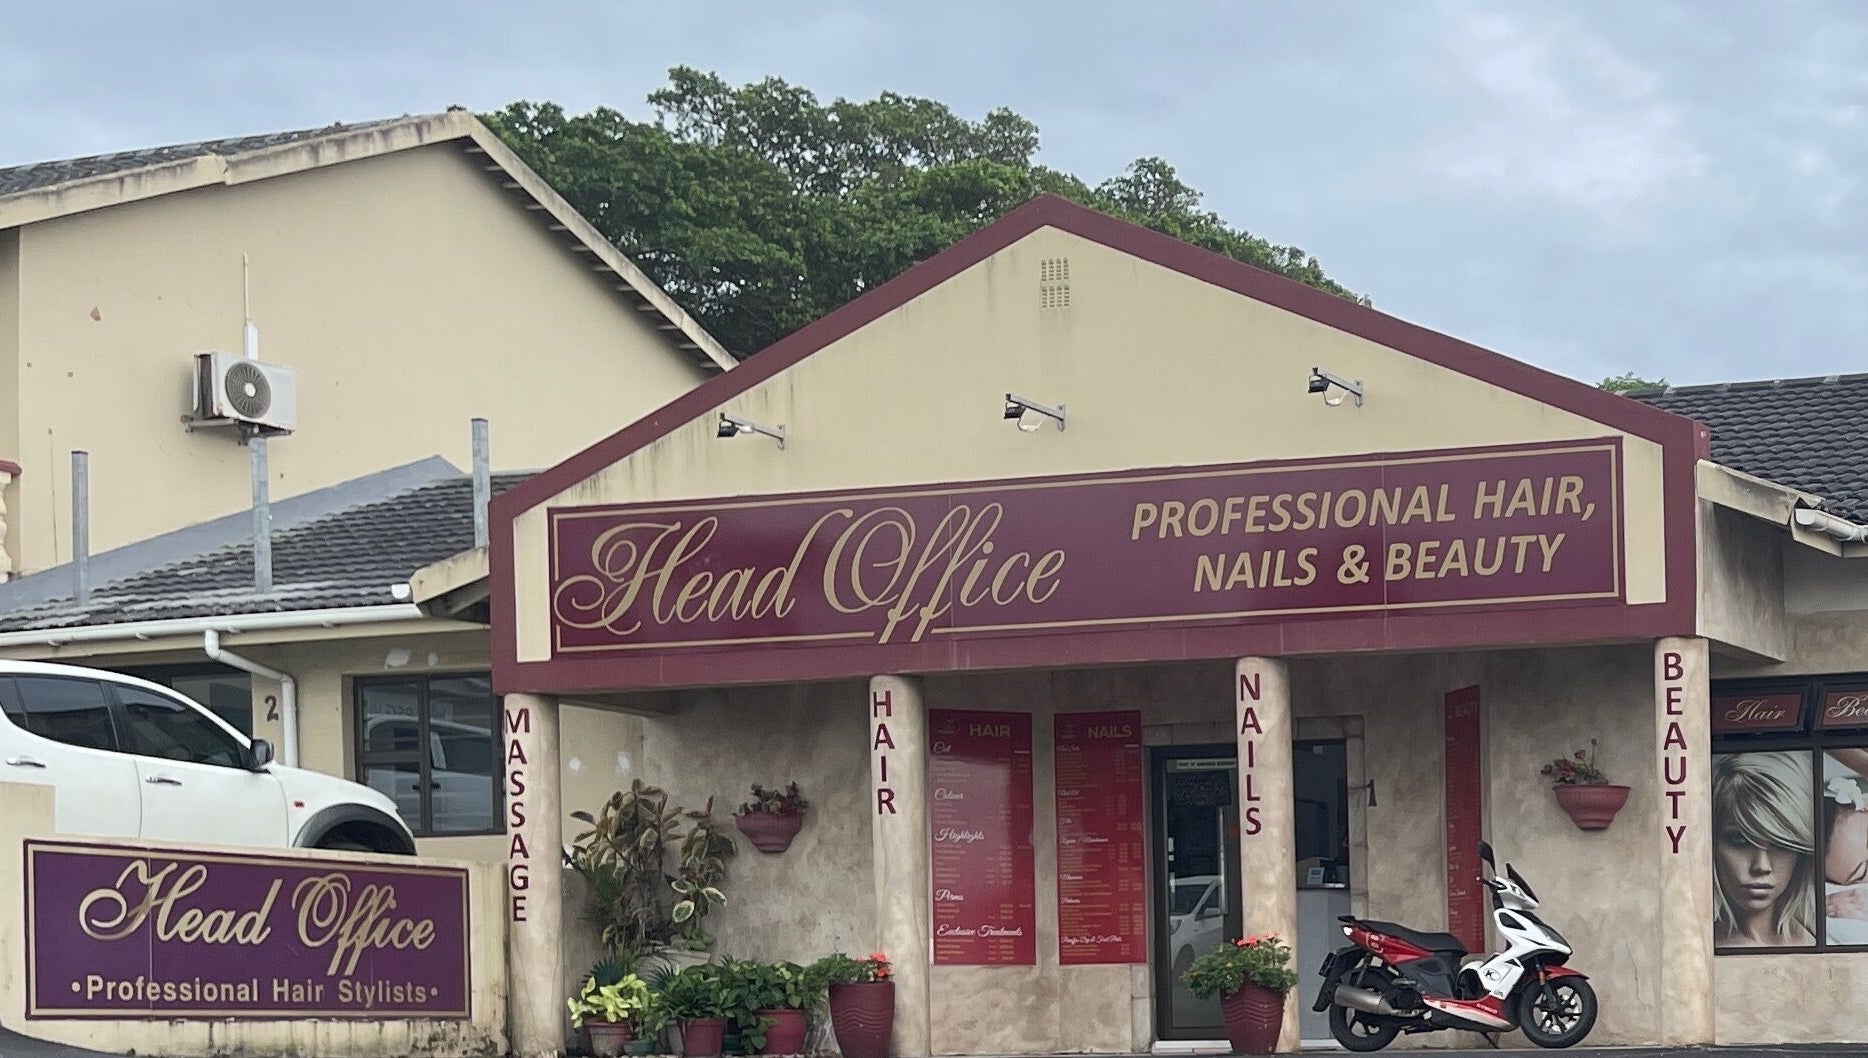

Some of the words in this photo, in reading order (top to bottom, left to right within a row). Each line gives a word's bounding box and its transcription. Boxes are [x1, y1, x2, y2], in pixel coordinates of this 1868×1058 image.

[1131, 483, 1456, 540] PROFESSIONAL
[1473, 475, 1597, 521] HAIR,
[554, 508, 853, 636] Head
[823, 502, 1066, 645] Office
[1193, 547, 1318, 592] NAILS
[1336, 544, 1370, 584] &
[1385, 533, 1567, 582] BEAUTY
[264, 695, 279, 722] 2
[969, 723, 1011, 737] HAIR
[1088, 724, 1133, 739] NAILS
[1724, 700, 1787, 722] Hair
[873, 690, 896, 815] HAIR
[1240, 673, 1263, 836] NAILS
[1664, 652, 1688, 854] BEAUTY
[505, 708, 531, 922] MASSAGE
[934, 827, 984, 844] Highlights
[79, 859, 284, 944] Head
[292, 873, 436, 976] Office
[977, 924, 1023, 937] Treatments
[273, 978, 325, 1003] Hair
